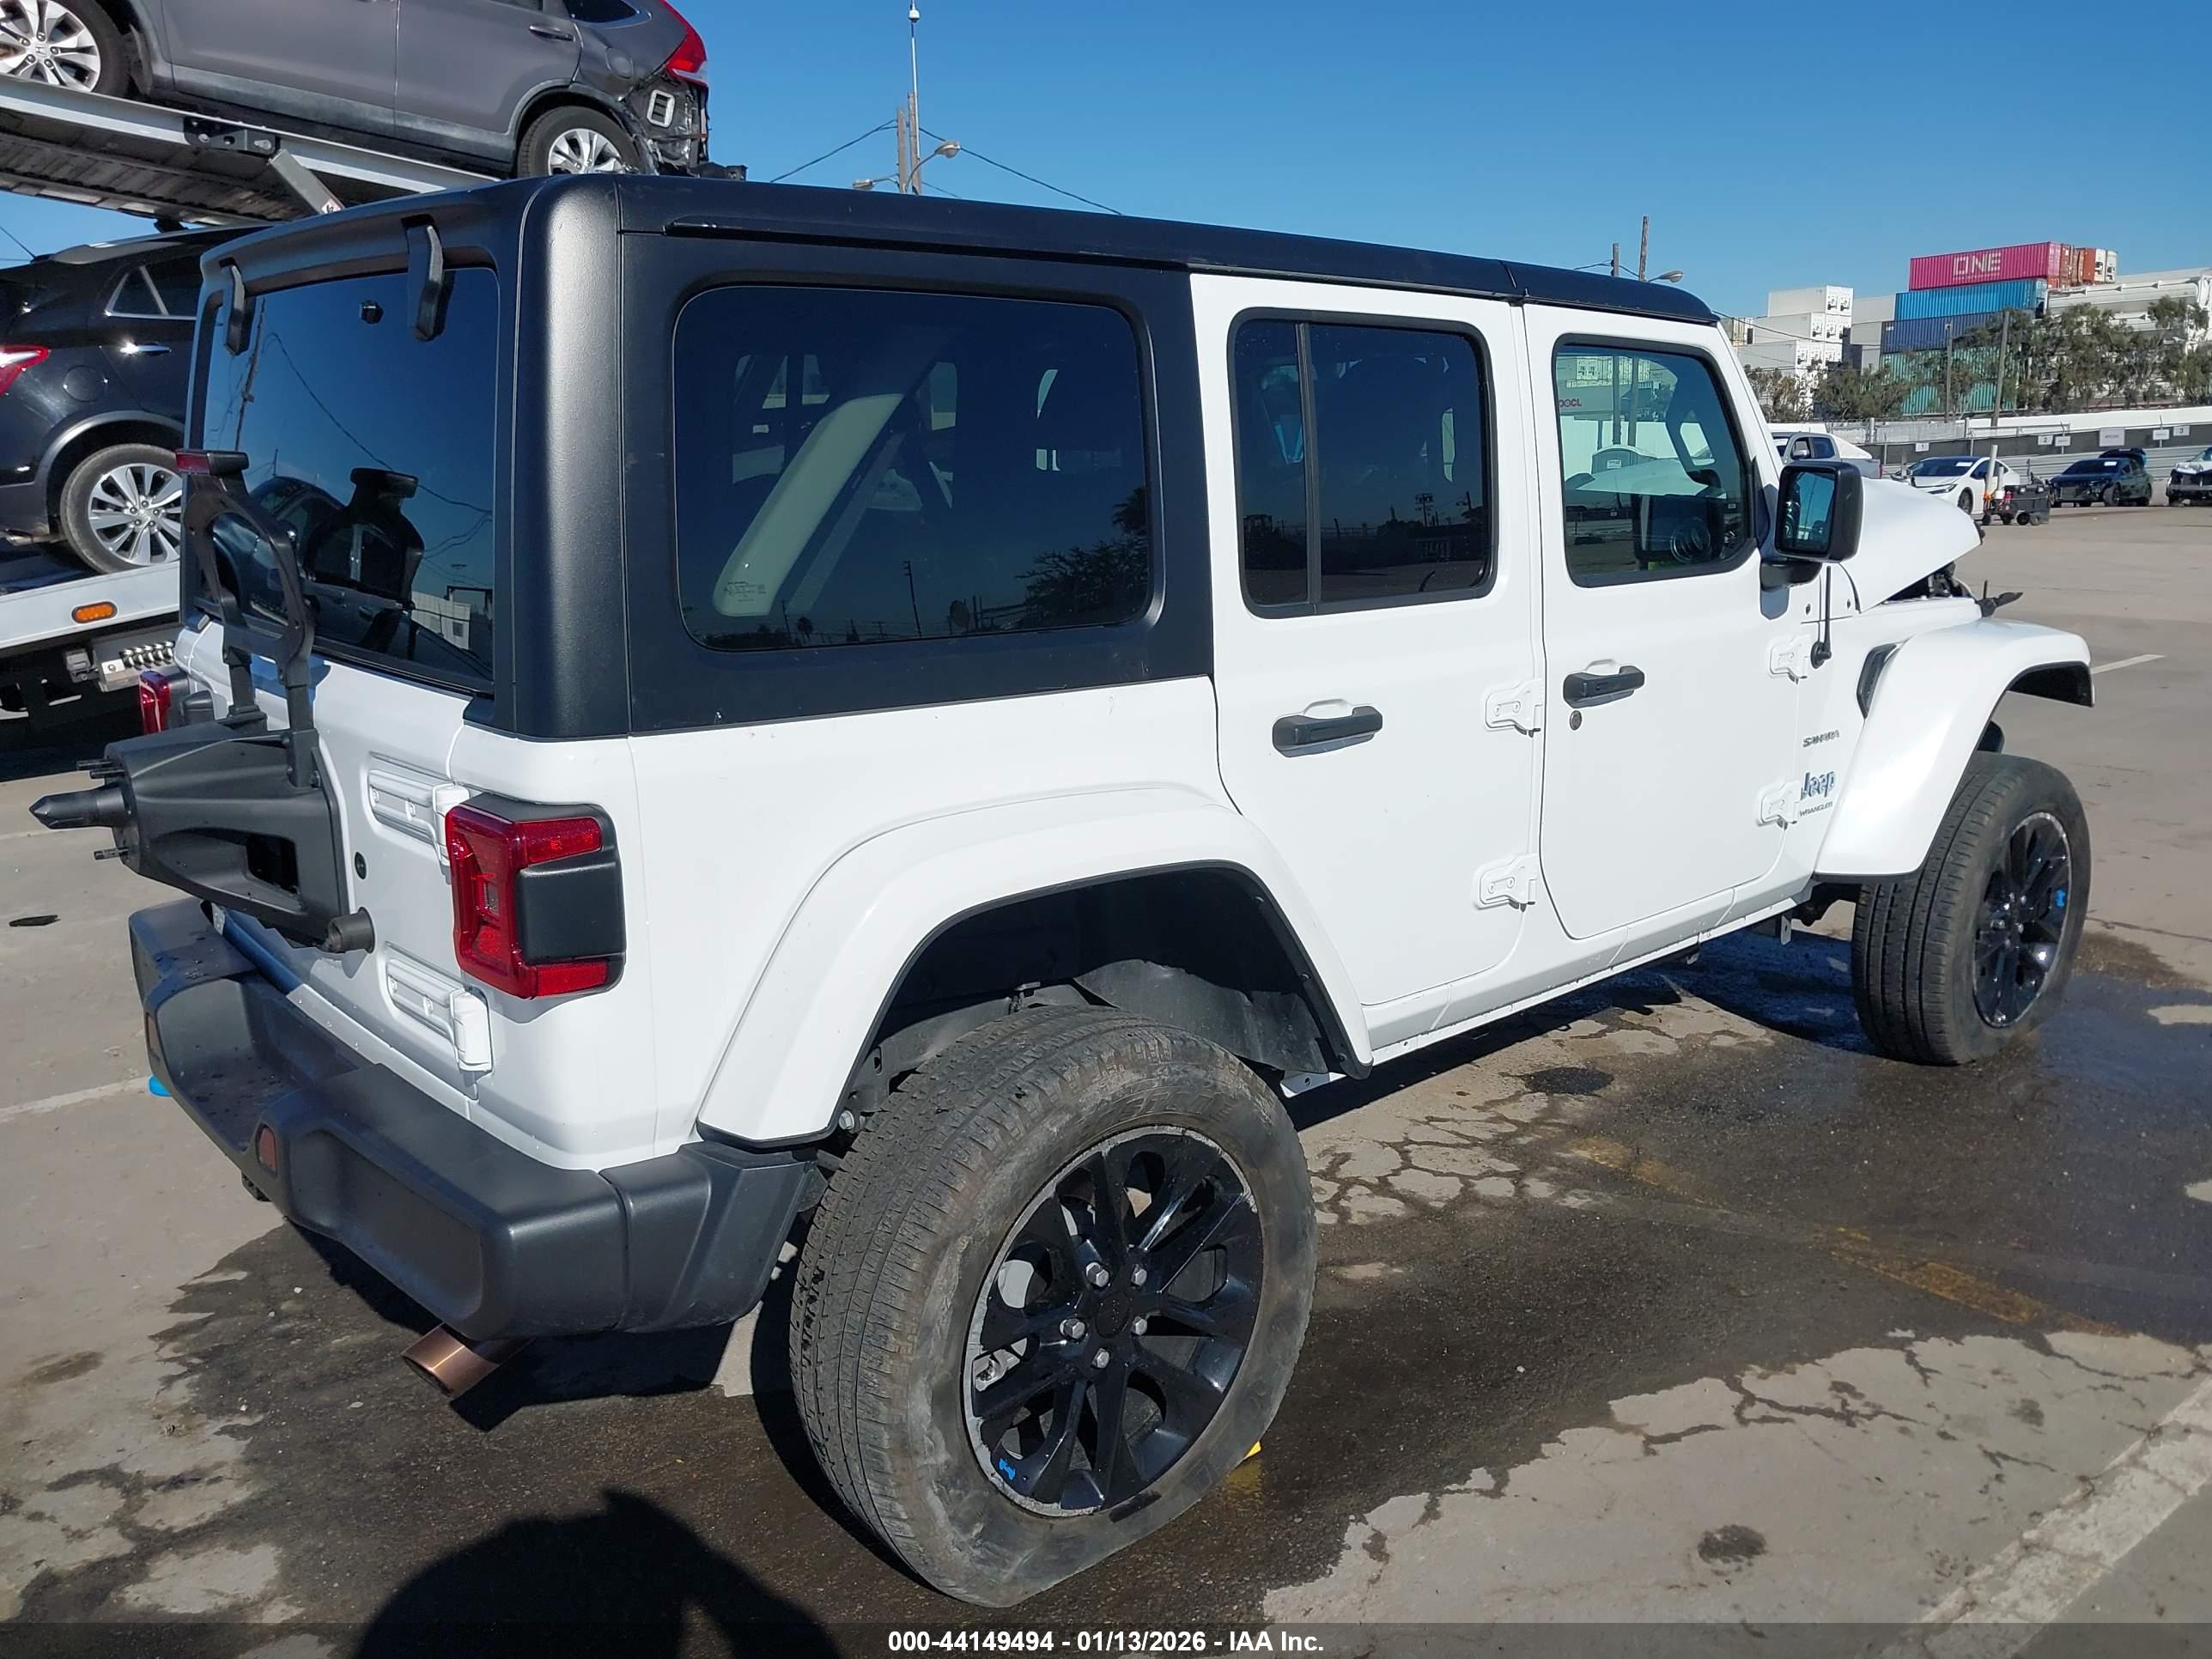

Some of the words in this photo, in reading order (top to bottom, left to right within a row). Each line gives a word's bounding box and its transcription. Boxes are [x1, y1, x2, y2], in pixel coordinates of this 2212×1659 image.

[1953, 252, 2001, 276] ONE
[1802, 729, 1841, 748] SAHARA
[1800, 771, 1836, 801] Jeep
[1799, 801, 1833, 817] WRANGLER
